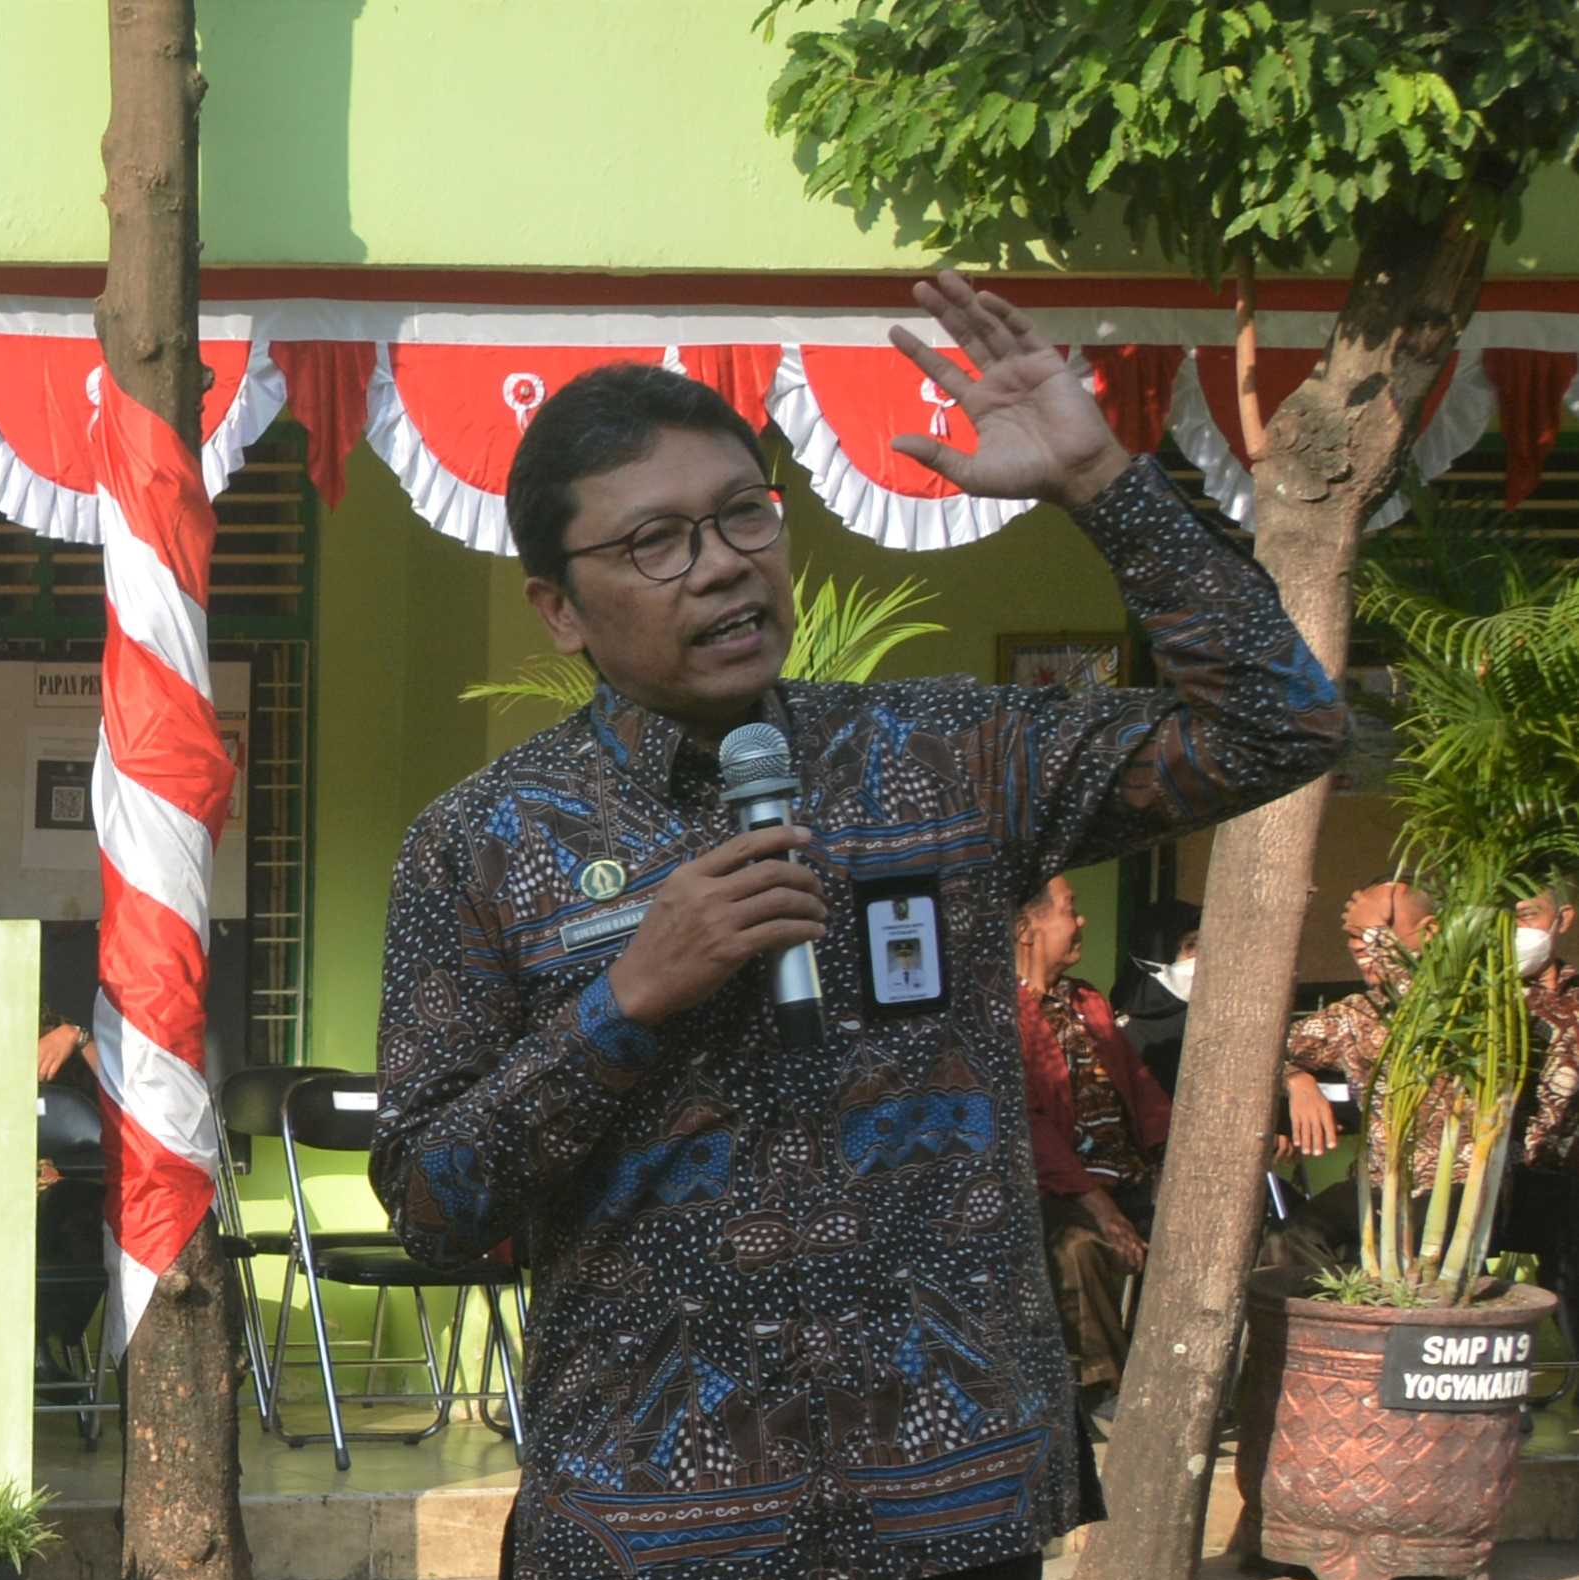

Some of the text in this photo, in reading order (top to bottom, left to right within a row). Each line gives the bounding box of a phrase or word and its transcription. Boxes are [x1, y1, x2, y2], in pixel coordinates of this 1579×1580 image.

[38, 674, 77, 696] PAPAN
[1422, 1333, 1530, 1366] SMP N 9
